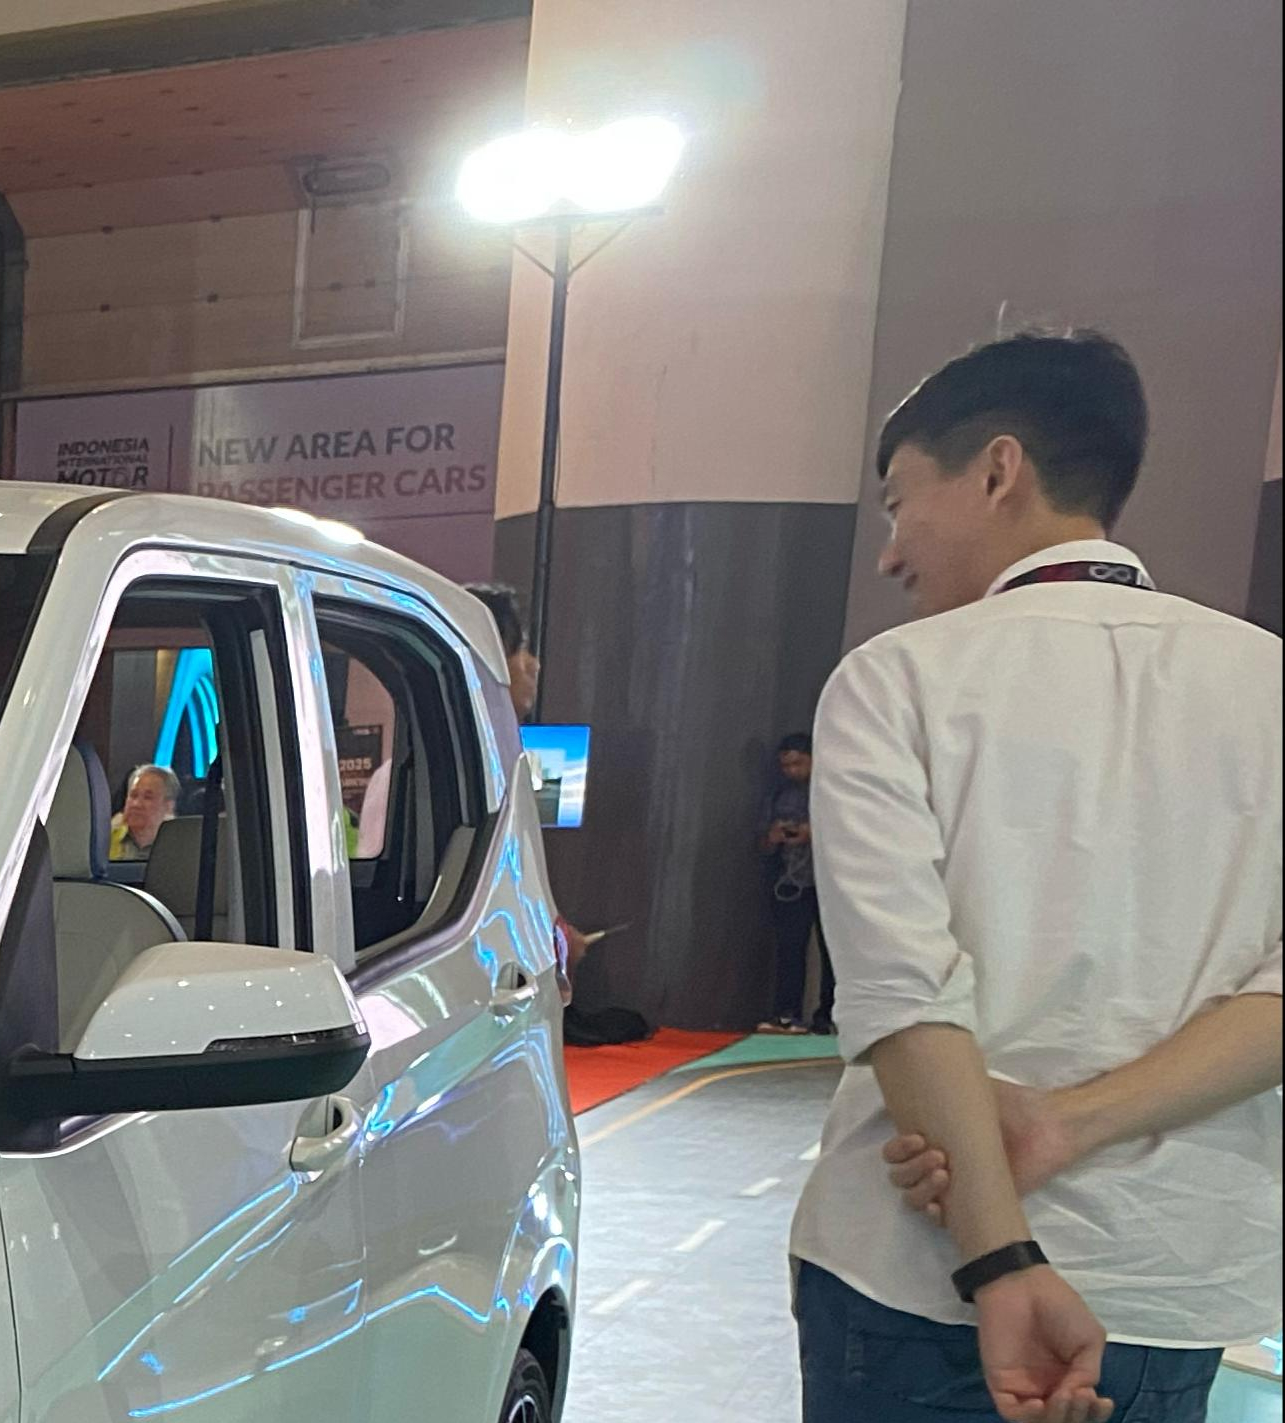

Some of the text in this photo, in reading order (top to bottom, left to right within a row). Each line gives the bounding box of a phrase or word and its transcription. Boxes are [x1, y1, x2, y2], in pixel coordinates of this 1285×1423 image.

[57, 438, 150, 457] INDONESIA
[198, 423, 456, 467] NEW AREA FOR
[196, 464, 487, 504] PASSENGER CARS
